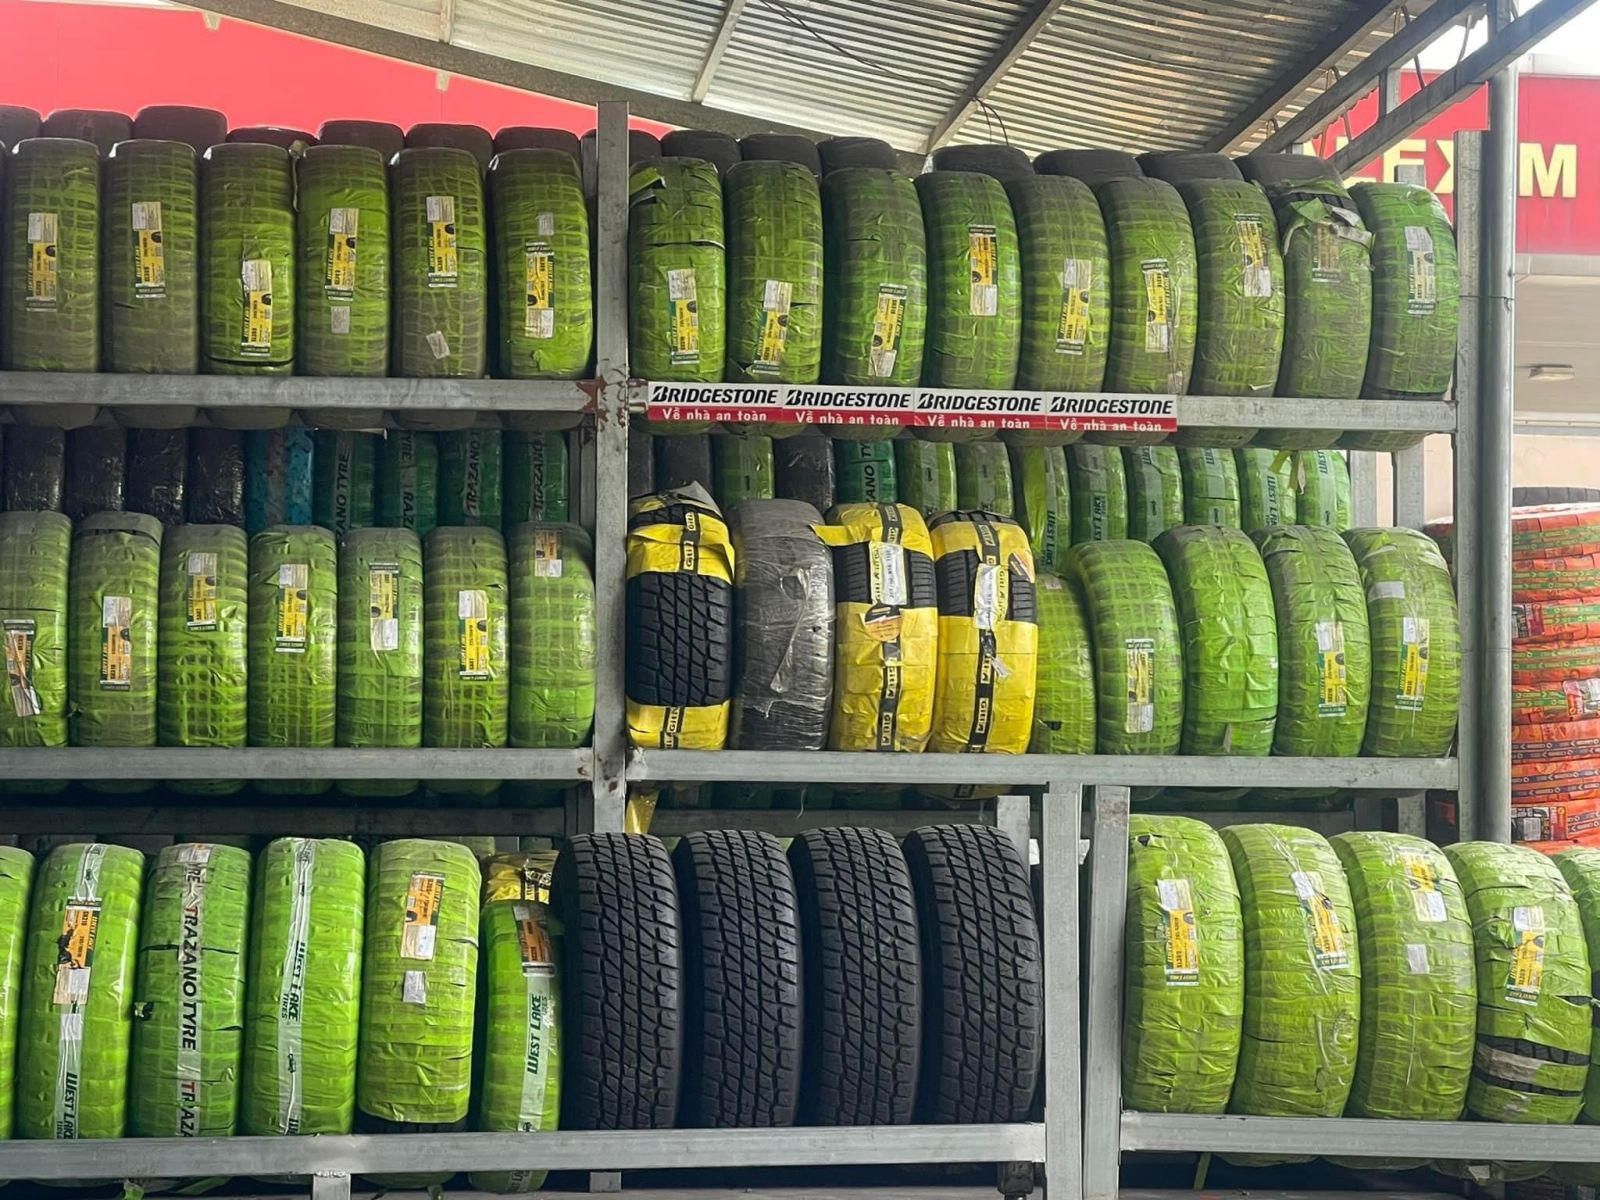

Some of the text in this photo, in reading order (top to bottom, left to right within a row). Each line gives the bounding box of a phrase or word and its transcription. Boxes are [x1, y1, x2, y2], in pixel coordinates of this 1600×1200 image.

[651, 386, 779, 404] BRIDGESTONE
[785, 389, 911, 408] BRIDGESTONE
[917, 393, 1042, 411] BRIDGESTONE
[663, 407, 767, 421] Về nhà an toàn
[1049, 396, 1174, 414] BRIDGESTONE
[795, 410, 899, 425] Về nhà an toàn
[927, 414, 1030, 428] Về nhà an toàn
[1060, 418, 1162, 431] Về nhà an toàn
[337, 454, 350, 490] TYRE
[187, 863, 200, 883] YRE
[181, 906, 199, 1051] TRAZANO TYRE
[288, 941, 306, 1021] WEST LAKE
[526, 993, 544, 1074] WEST LAKE
[65, 1071, 79, 1110] WEST
[180, 1081, 195, 1137] TRAZA
